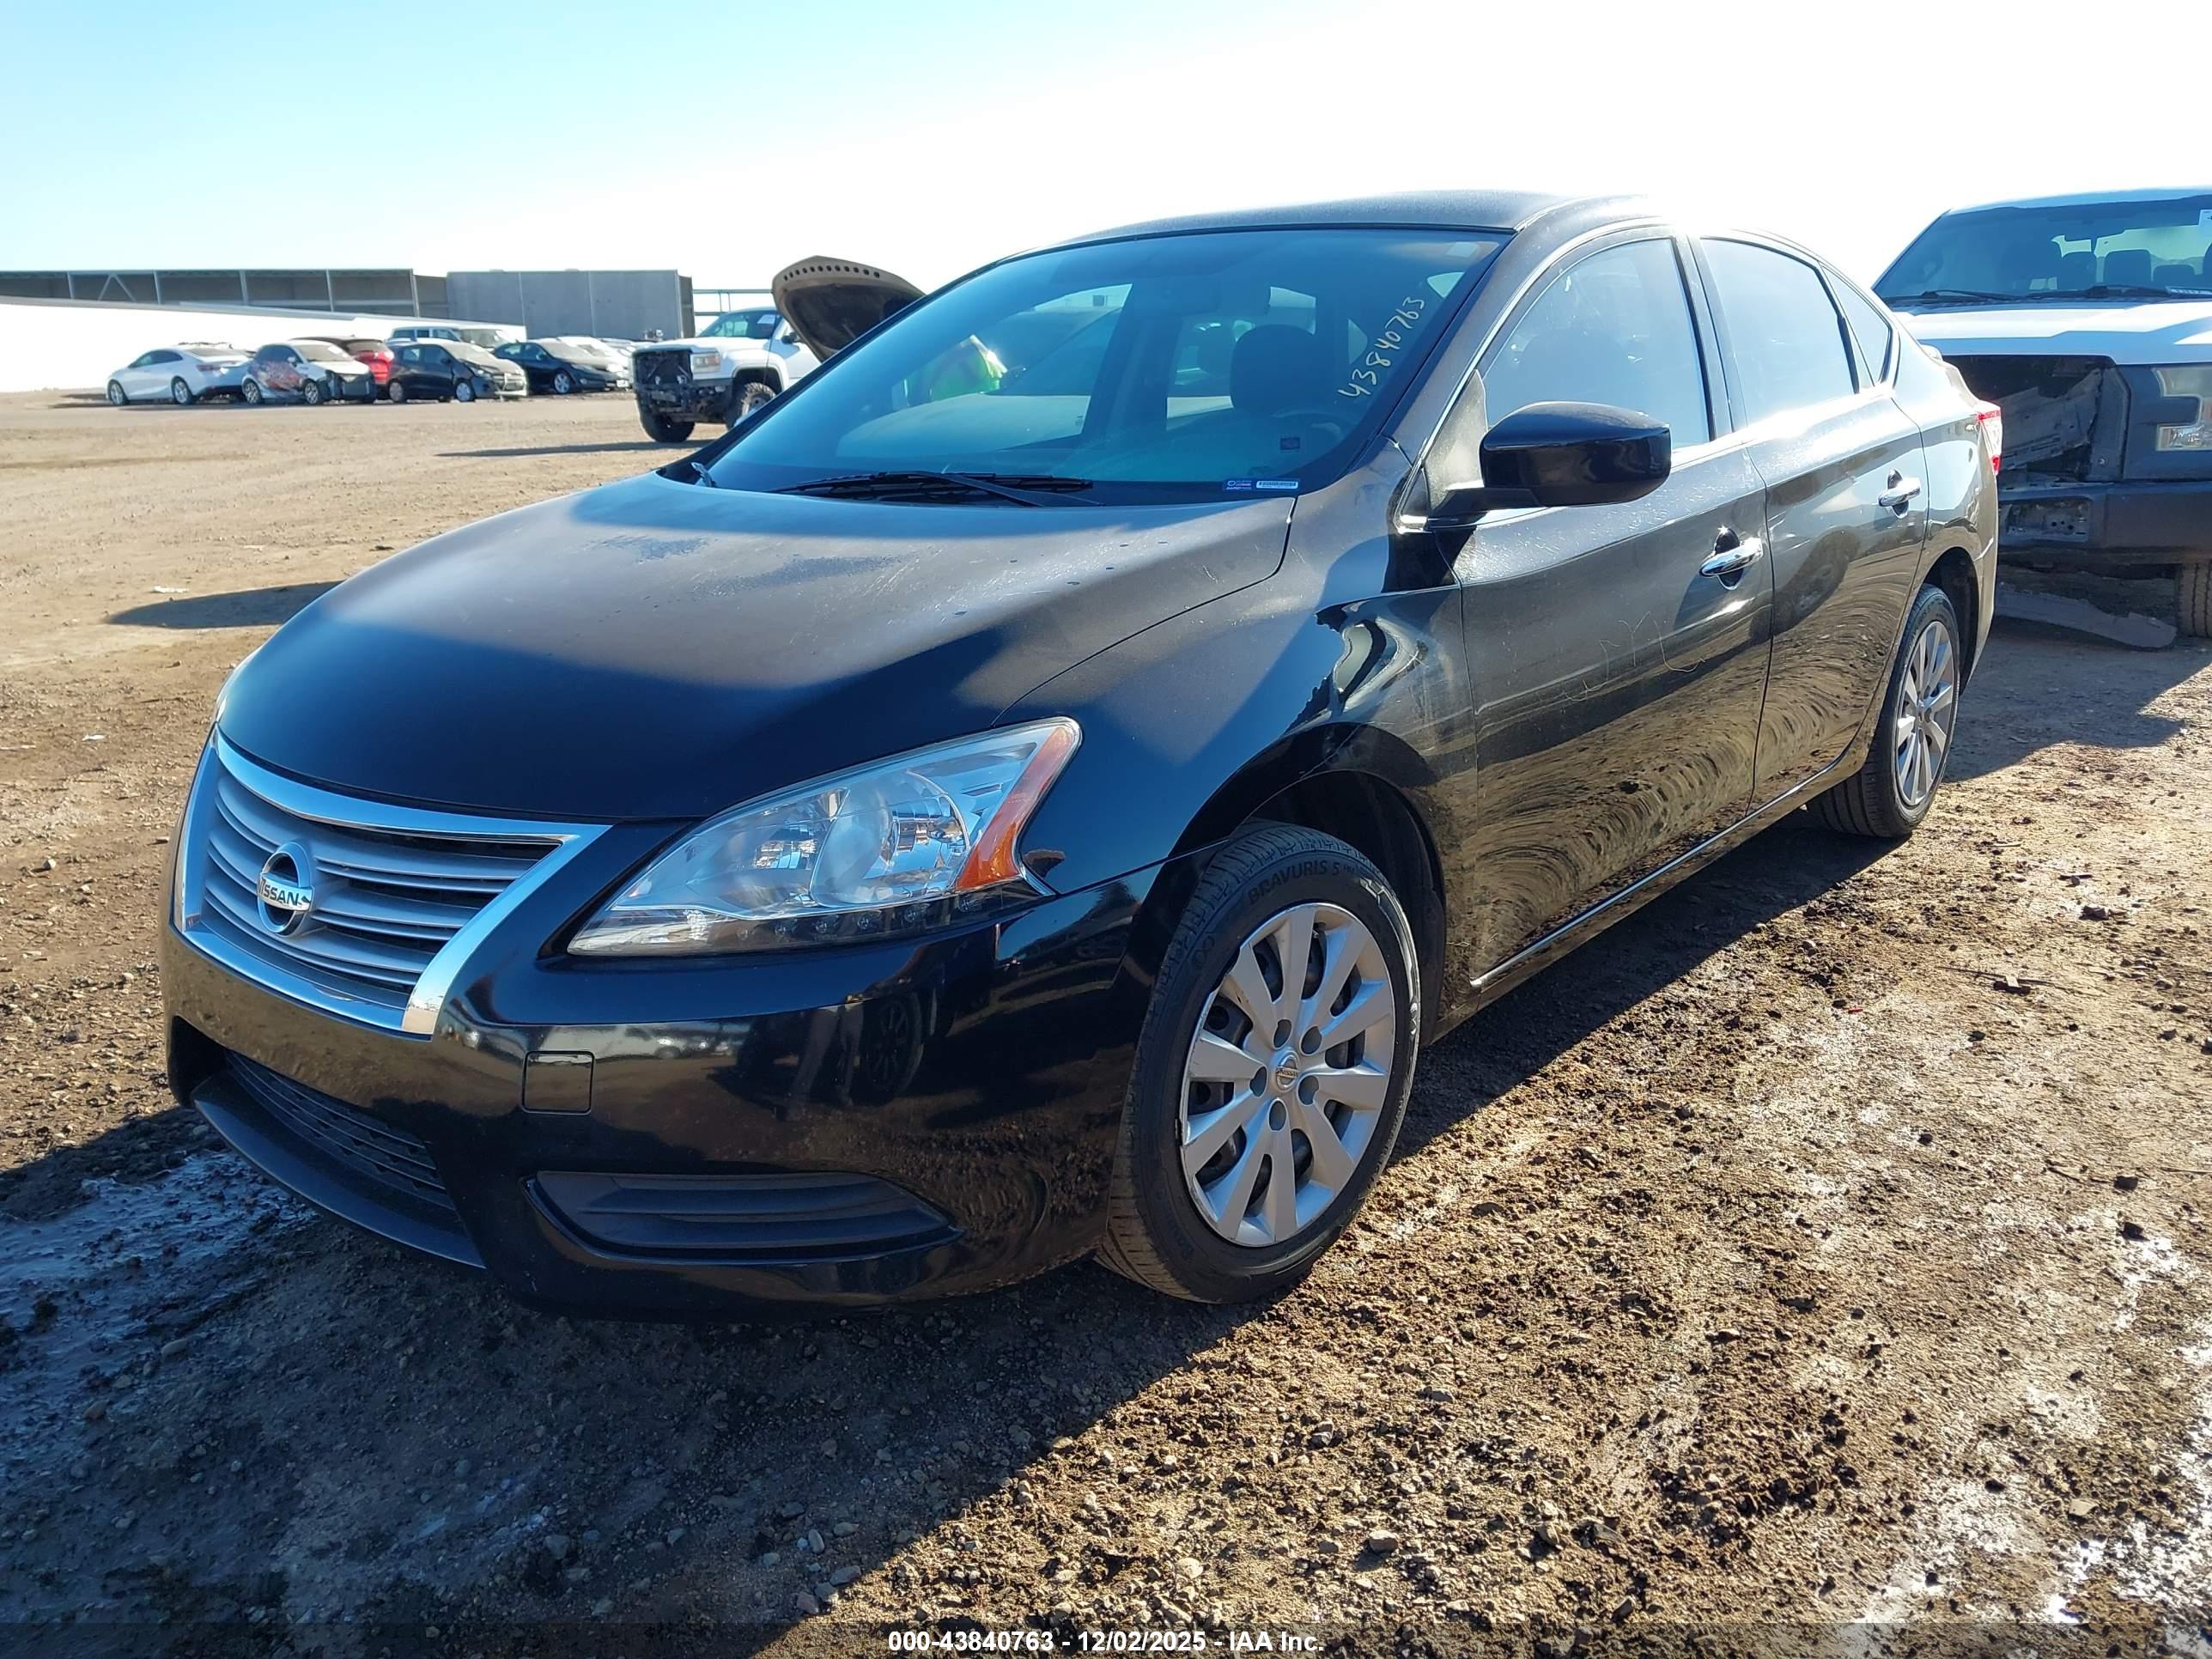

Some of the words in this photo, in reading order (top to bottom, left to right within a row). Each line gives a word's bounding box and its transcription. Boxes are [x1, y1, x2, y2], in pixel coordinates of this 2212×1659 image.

[1338, 296, 1425, 397] 43840763
[1249, 860, 1328, 904] BRAVURIS
[1332, 862, 1340, 876] 5
